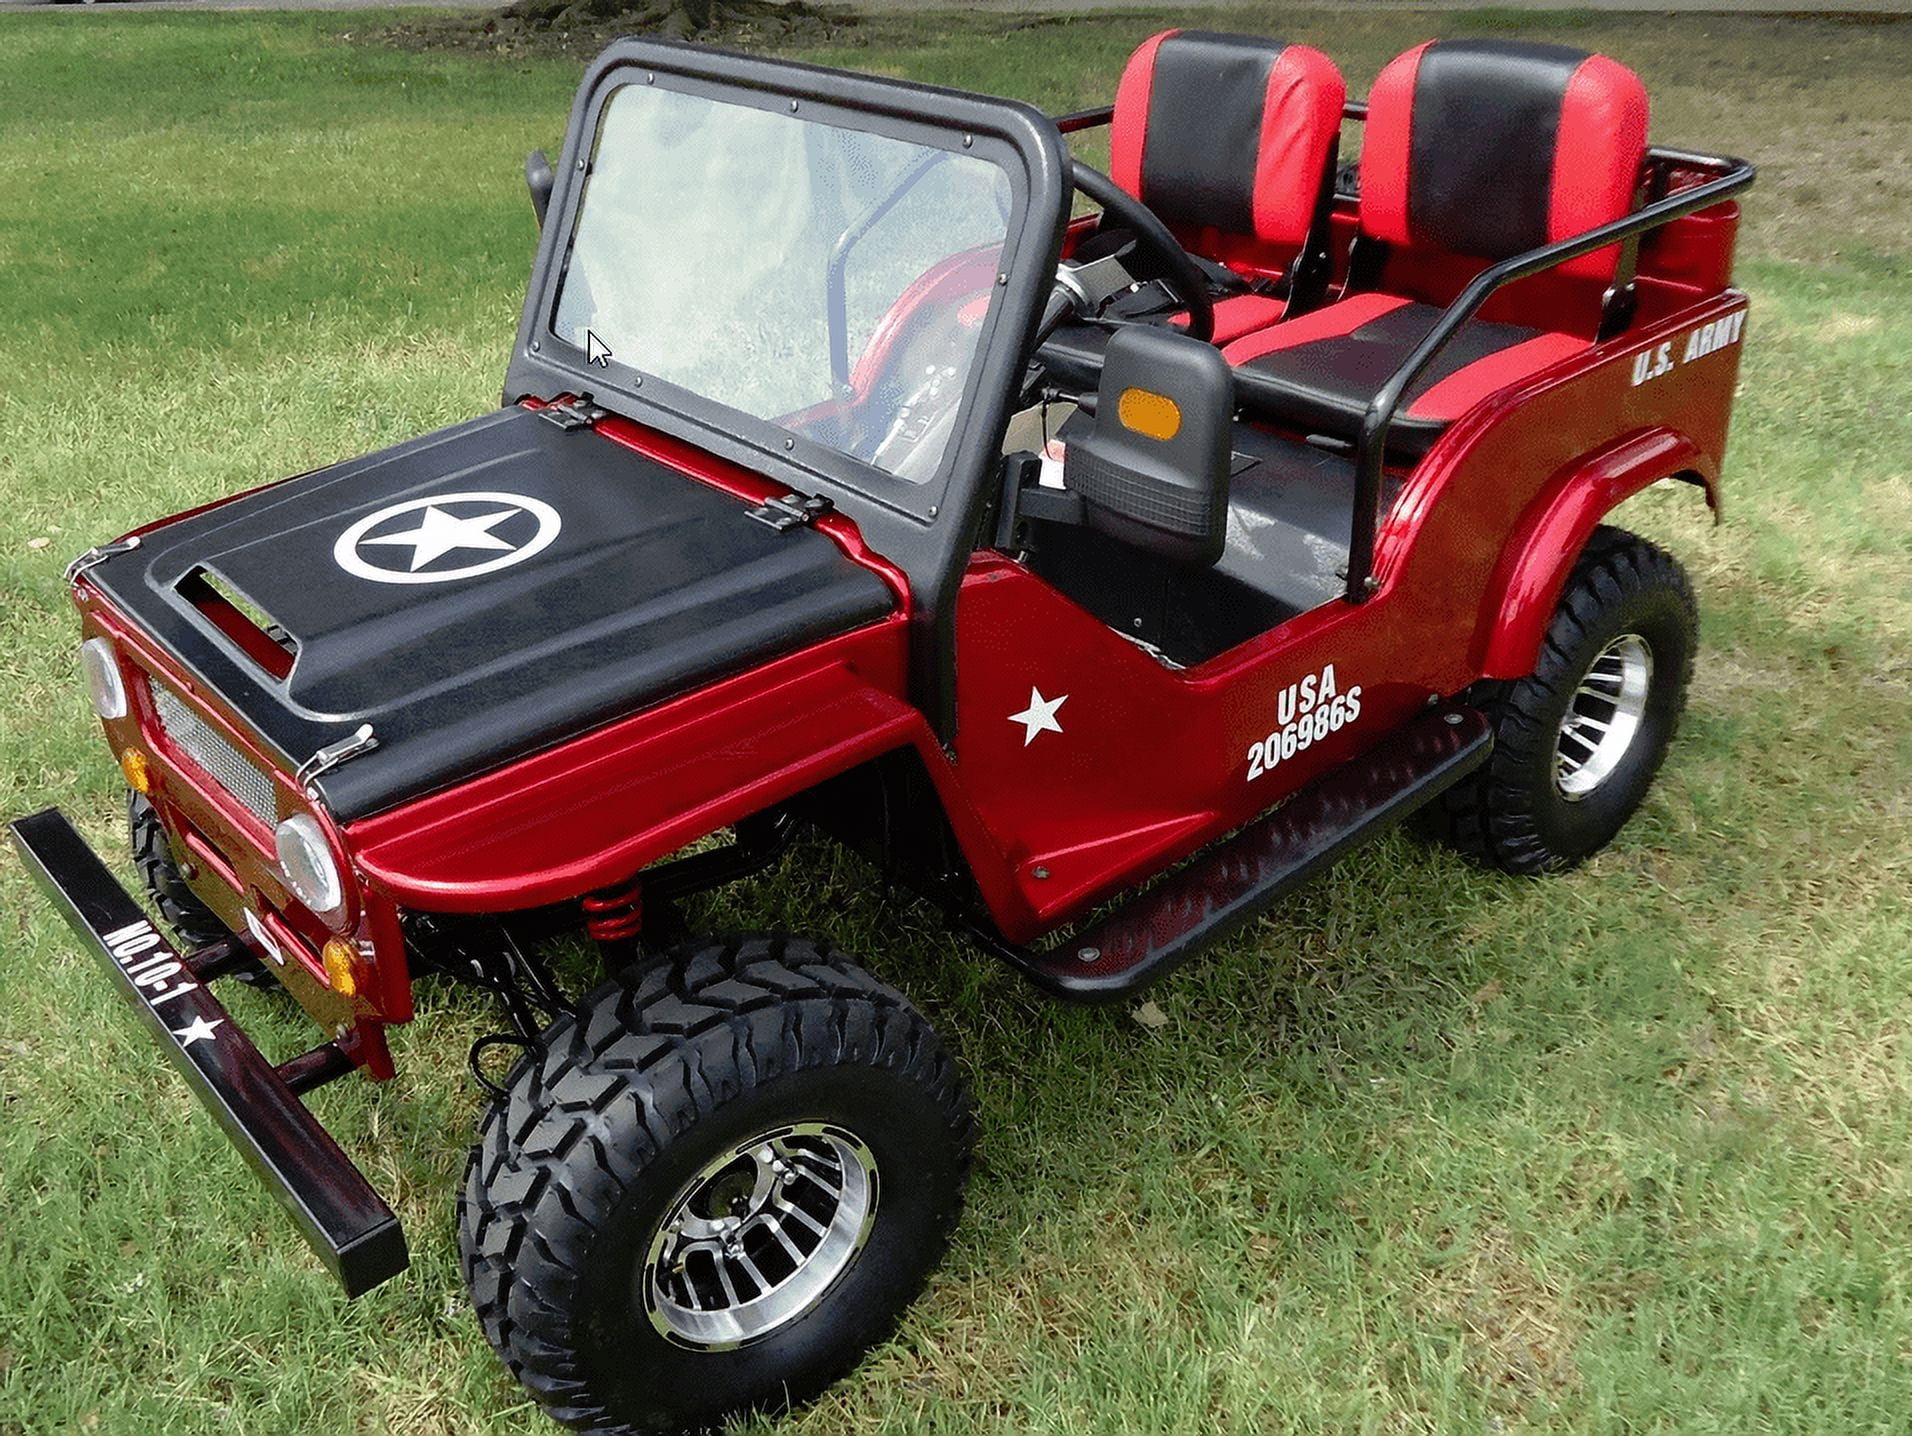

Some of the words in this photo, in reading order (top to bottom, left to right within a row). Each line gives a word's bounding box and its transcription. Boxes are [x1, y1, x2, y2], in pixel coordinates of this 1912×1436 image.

[1631, 341, 1675, 387] U.S.
[1682, 308, 1748, 364] ARMY
[1247, 685, 1362, 782] 206986S
[1277, 663, 1337, 726] USA
[102, 919, 199, 1006] NO.10-1
